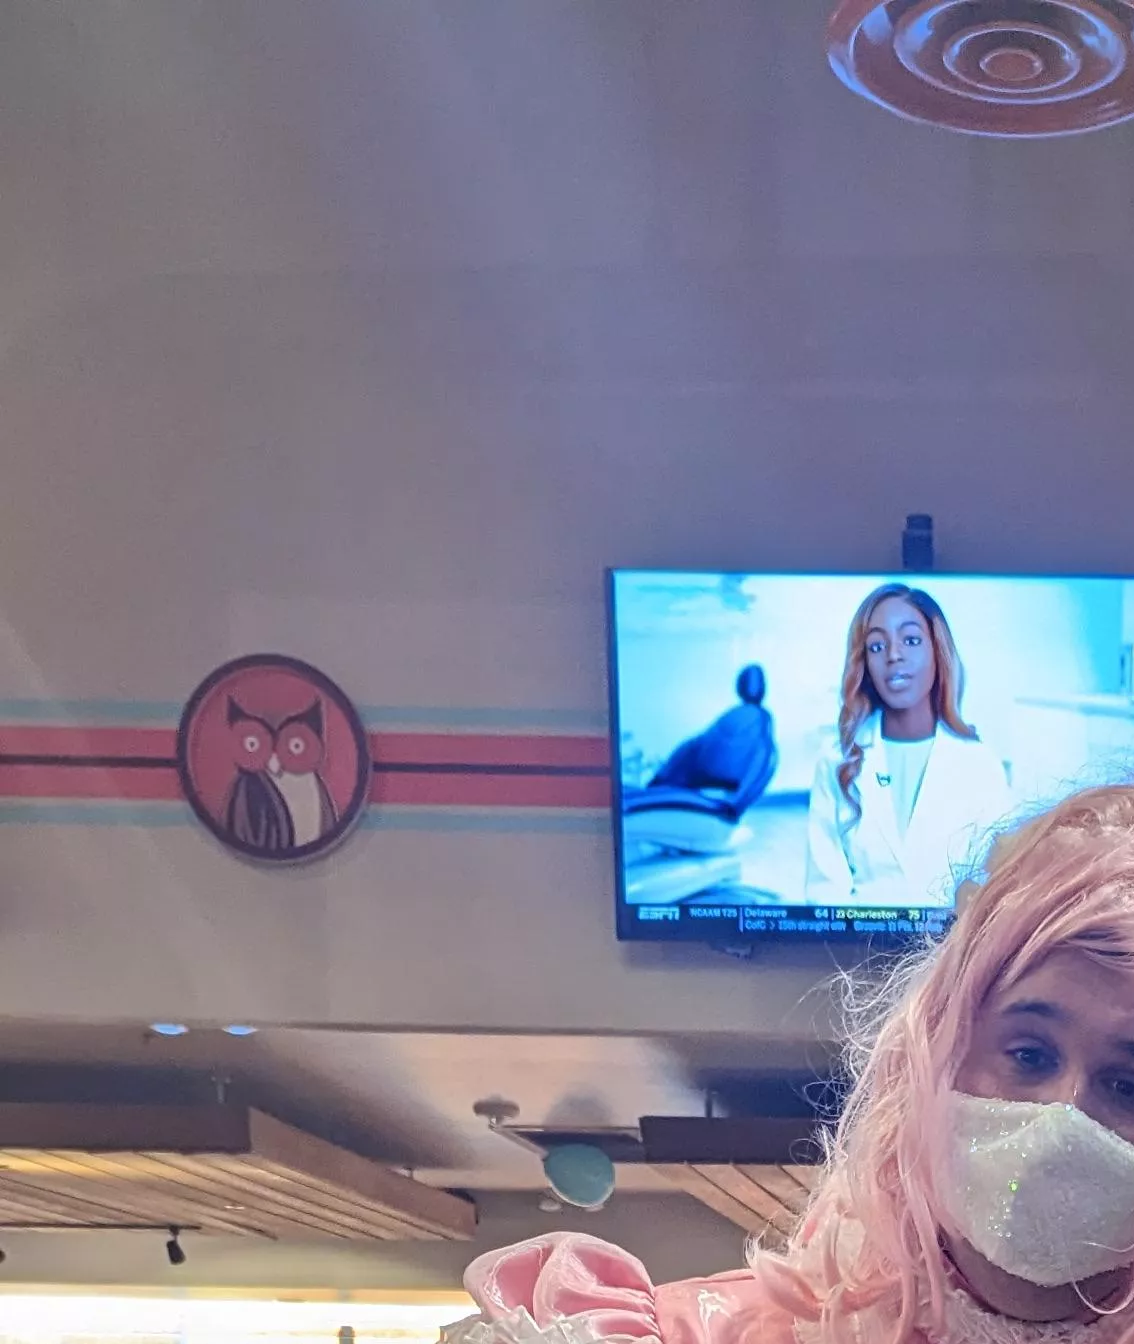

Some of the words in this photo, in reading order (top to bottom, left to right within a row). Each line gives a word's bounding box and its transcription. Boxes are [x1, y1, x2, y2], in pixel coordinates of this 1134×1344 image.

[638, 906, 680, 920] ESPN
[744, 907, 787, 919] Delaware
[814, 908, 828, 919] 64
[846, 909, 897, 920] Charleston
[908, 909, 920, 920] 75
